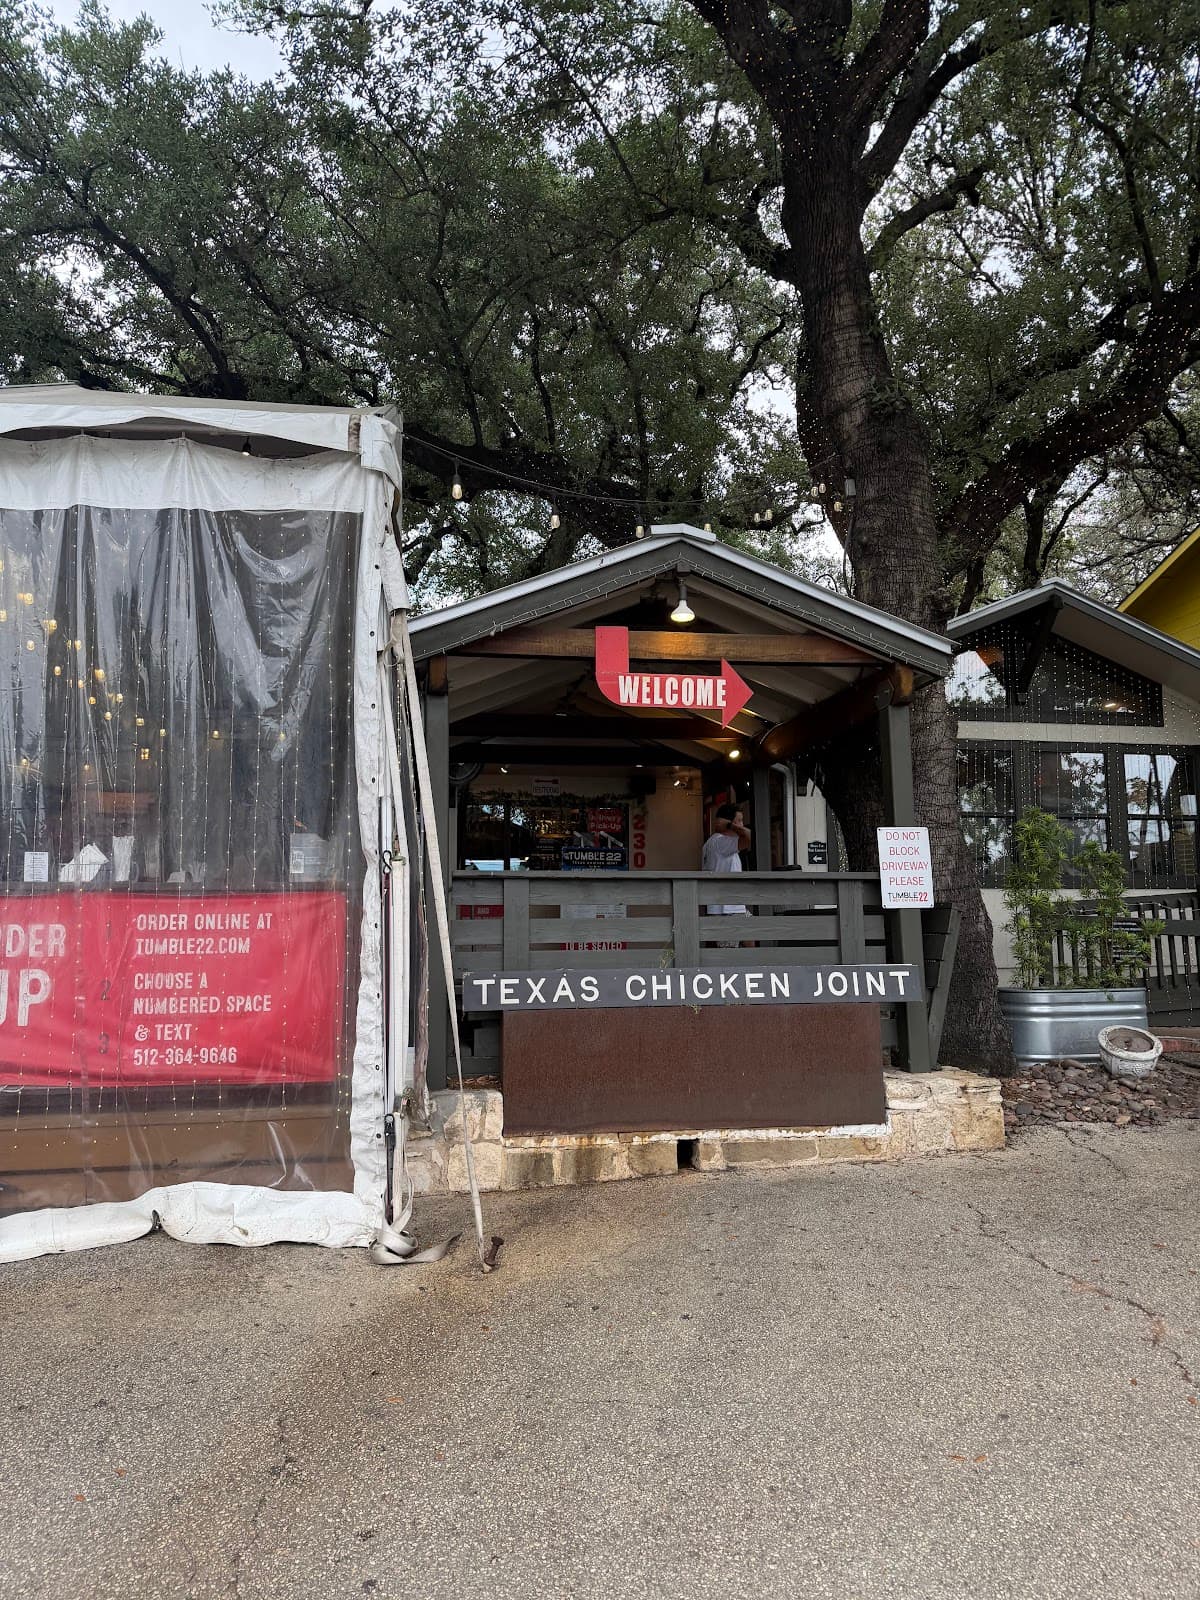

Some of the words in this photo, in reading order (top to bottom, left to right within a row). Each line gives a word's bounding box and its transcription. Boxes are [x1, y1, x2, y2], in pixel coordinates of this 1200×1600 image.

[618, 675, 727, 707] WELCOME
[886, 832, 899, 841] DO
[902, 832, 920, 841] NOT
[889, 847, 920, 856] BLOCK
[882, 861, 928, 871] DRIVEWAY
[889, 876, 924, 886] PLEASE
[136, 914, 188, 931] ORDER
[194, 913, 250, 930] ONLINE
[256, 912, 273, 929] AT
[0, 924, 67, 958] DER
[135, 937, 251, 955] TUMBLE22.COM
[134, 972, 194, 990] CHOOSE
[199, 972, 209, 989] A
[472, 976, 600, 1005] TEXAS
[625, 972, 791, 1002] CHICKEN
[813, 970, 910, 998] JOINT
[133, 996, 221, 1015] NUMBERED
[226, 994, 272, 1013] SPACE
[134, 1024, 150, 1042] &
[154, 1023, 193, 1041] TEXT
[133, 1047, 237, 1066] 512-364-9646
